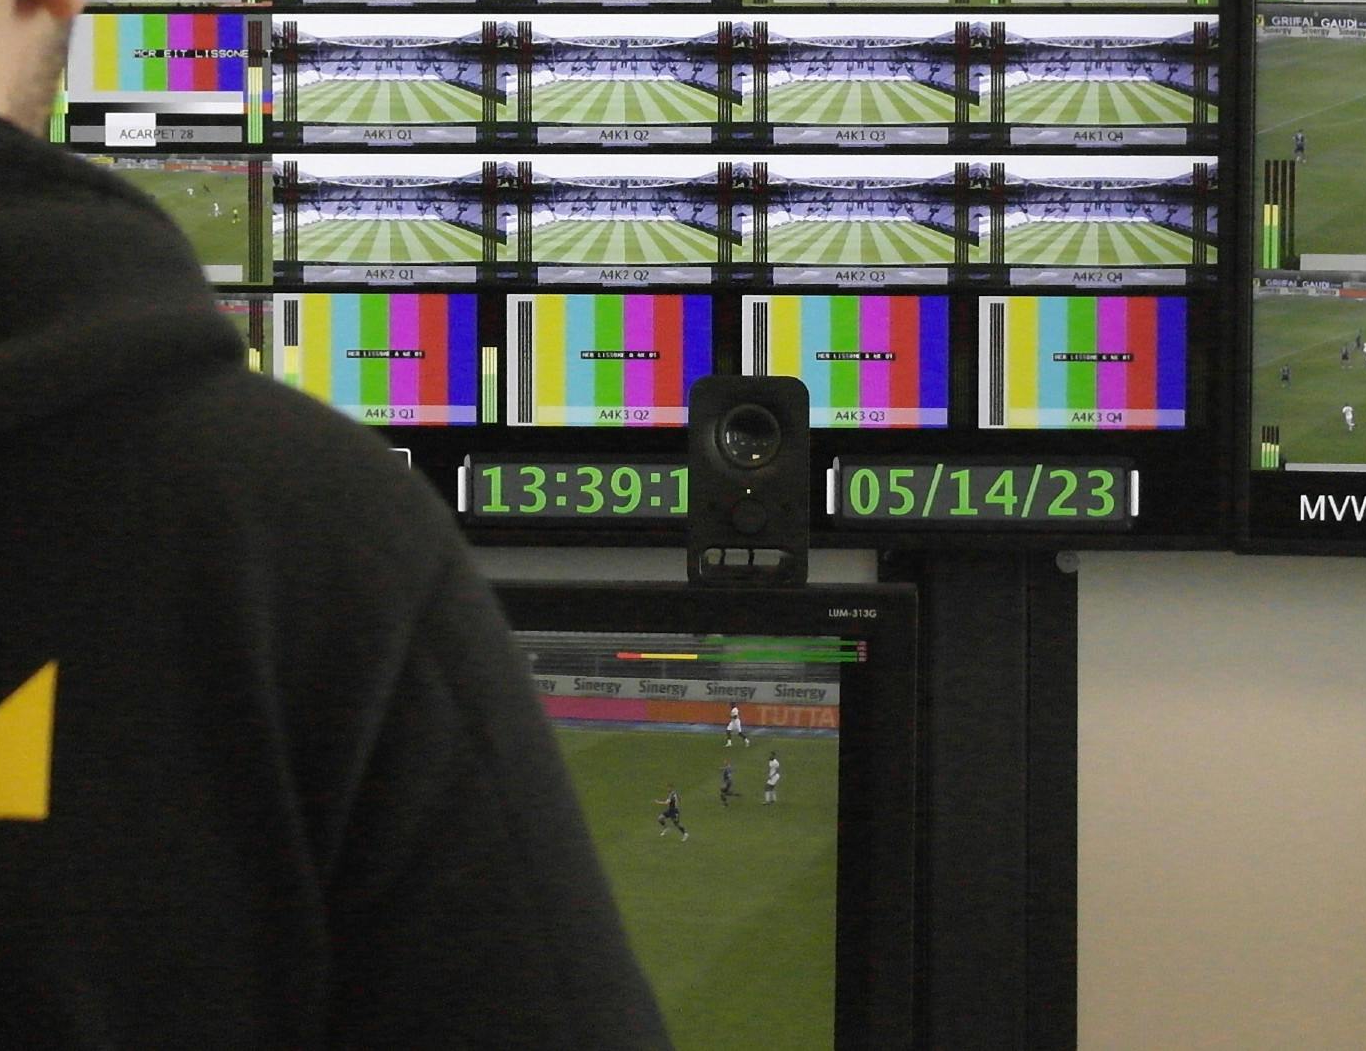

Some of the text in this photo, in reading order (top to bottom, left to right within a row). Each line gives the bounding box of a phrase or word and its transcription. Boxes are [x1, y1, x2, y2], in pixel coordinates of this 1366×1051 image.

[120, 129, 194, 140] ACARPET 28
[363, 130, 412, 141] A4K1 Q1
[599, 130, 649, 142] A4K1 Q2
[836, 130, 885, 142] A4K1 Q3
[365, 269, 415, 281] A4K2 Q1
[599, 270, 649, 282] A4K2 Q2
[836, 271, 885, 282] A4K2 Q3
[399, 408, 414, 420] Q1
[482, 466, 688, 514] 13:39:1
[850, 464, 1115, 518] 05/14/23
[573, 678, 621, 695] Sinergy
[639, 680, 687, 697] Sinergy
[706, 682, 756, 700] Sinergy
[774, 684, 826, 701] Sinergy
[757, 706, 835, 727] TUTTA
